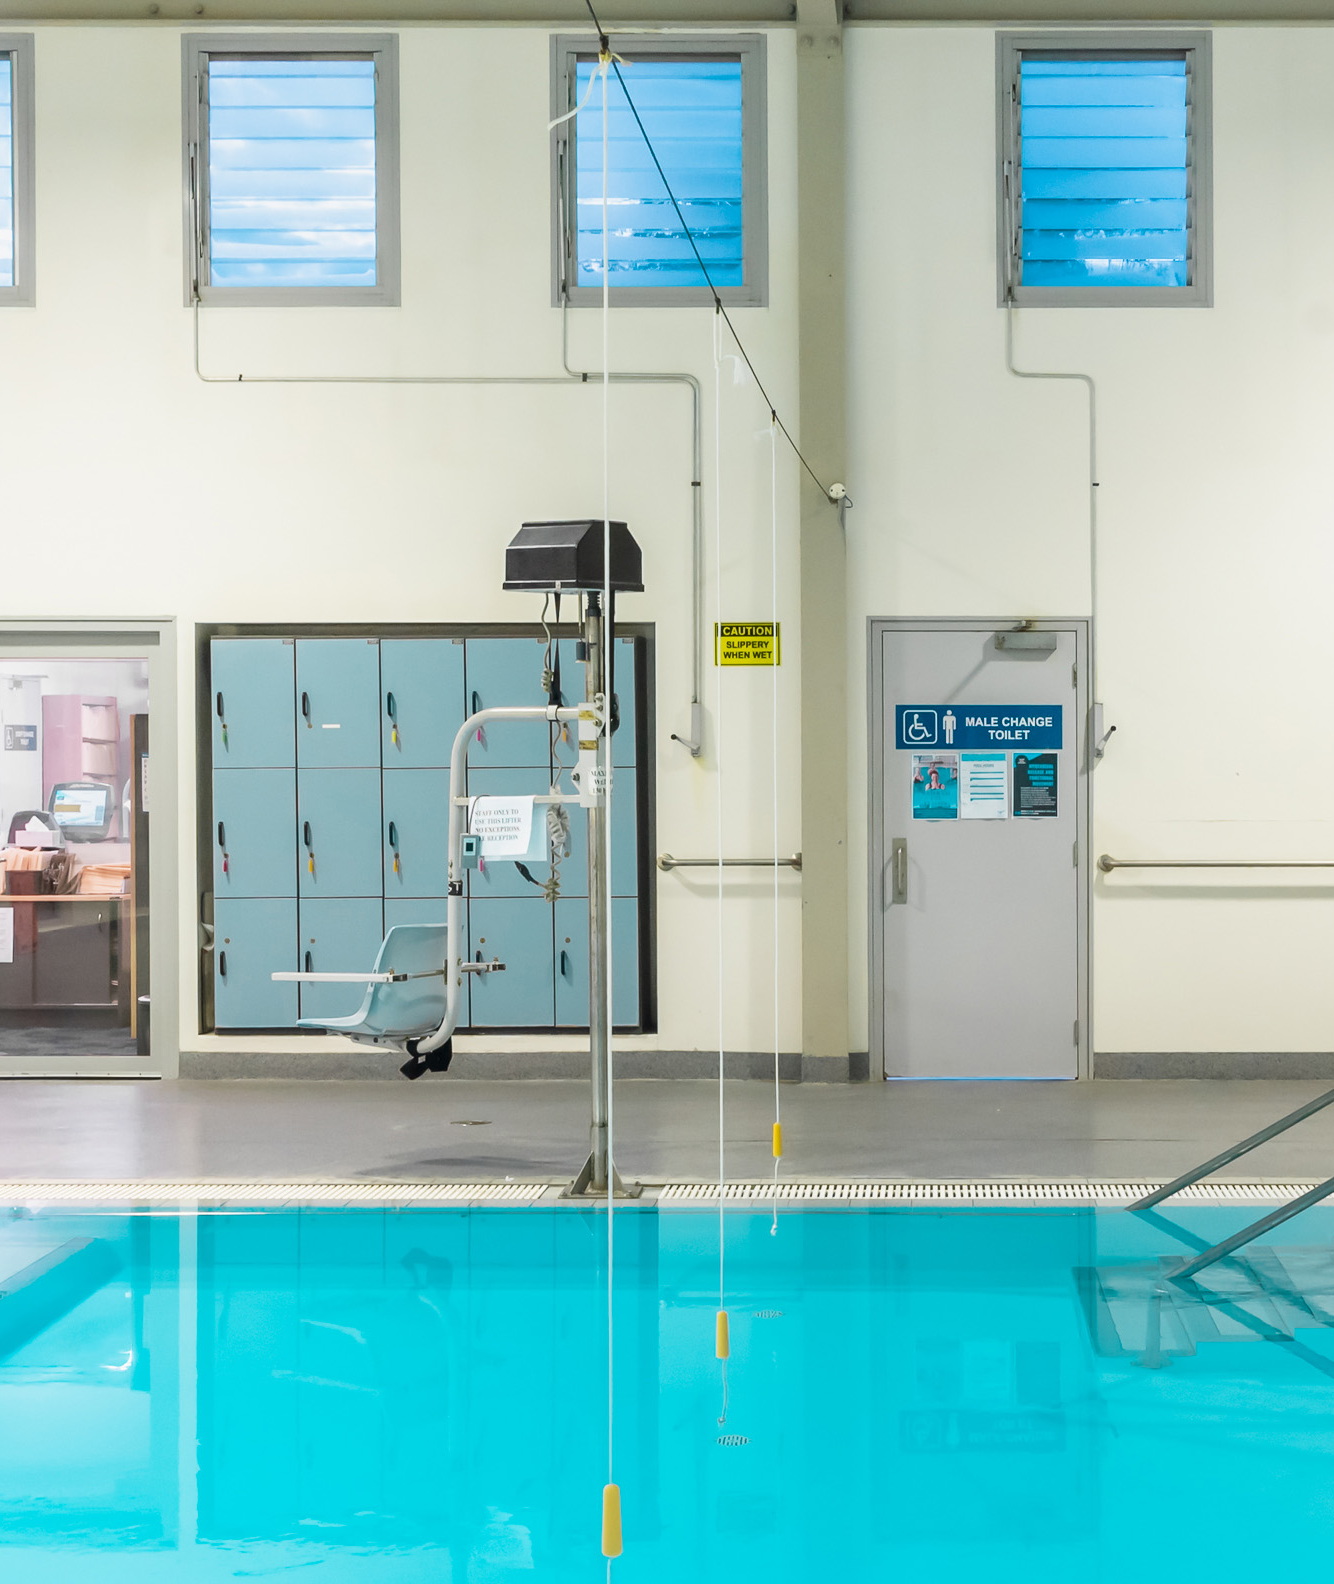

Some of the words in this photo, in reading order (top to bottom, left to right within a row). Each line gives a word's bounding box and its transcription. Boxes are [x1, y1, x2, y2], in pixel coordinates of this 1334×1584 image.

[723, 626, 772, 635] CAUTION
[726, 641, 769, 649] SLIPPERY
[723, 651, 750, 659] WHEN
[752, 651, 772, 659] WET
[965, 717, 998, 726] MALE
[1001, 716, 1052, 726] CHANGE
[988, 730, 1030, 740] TOILET
